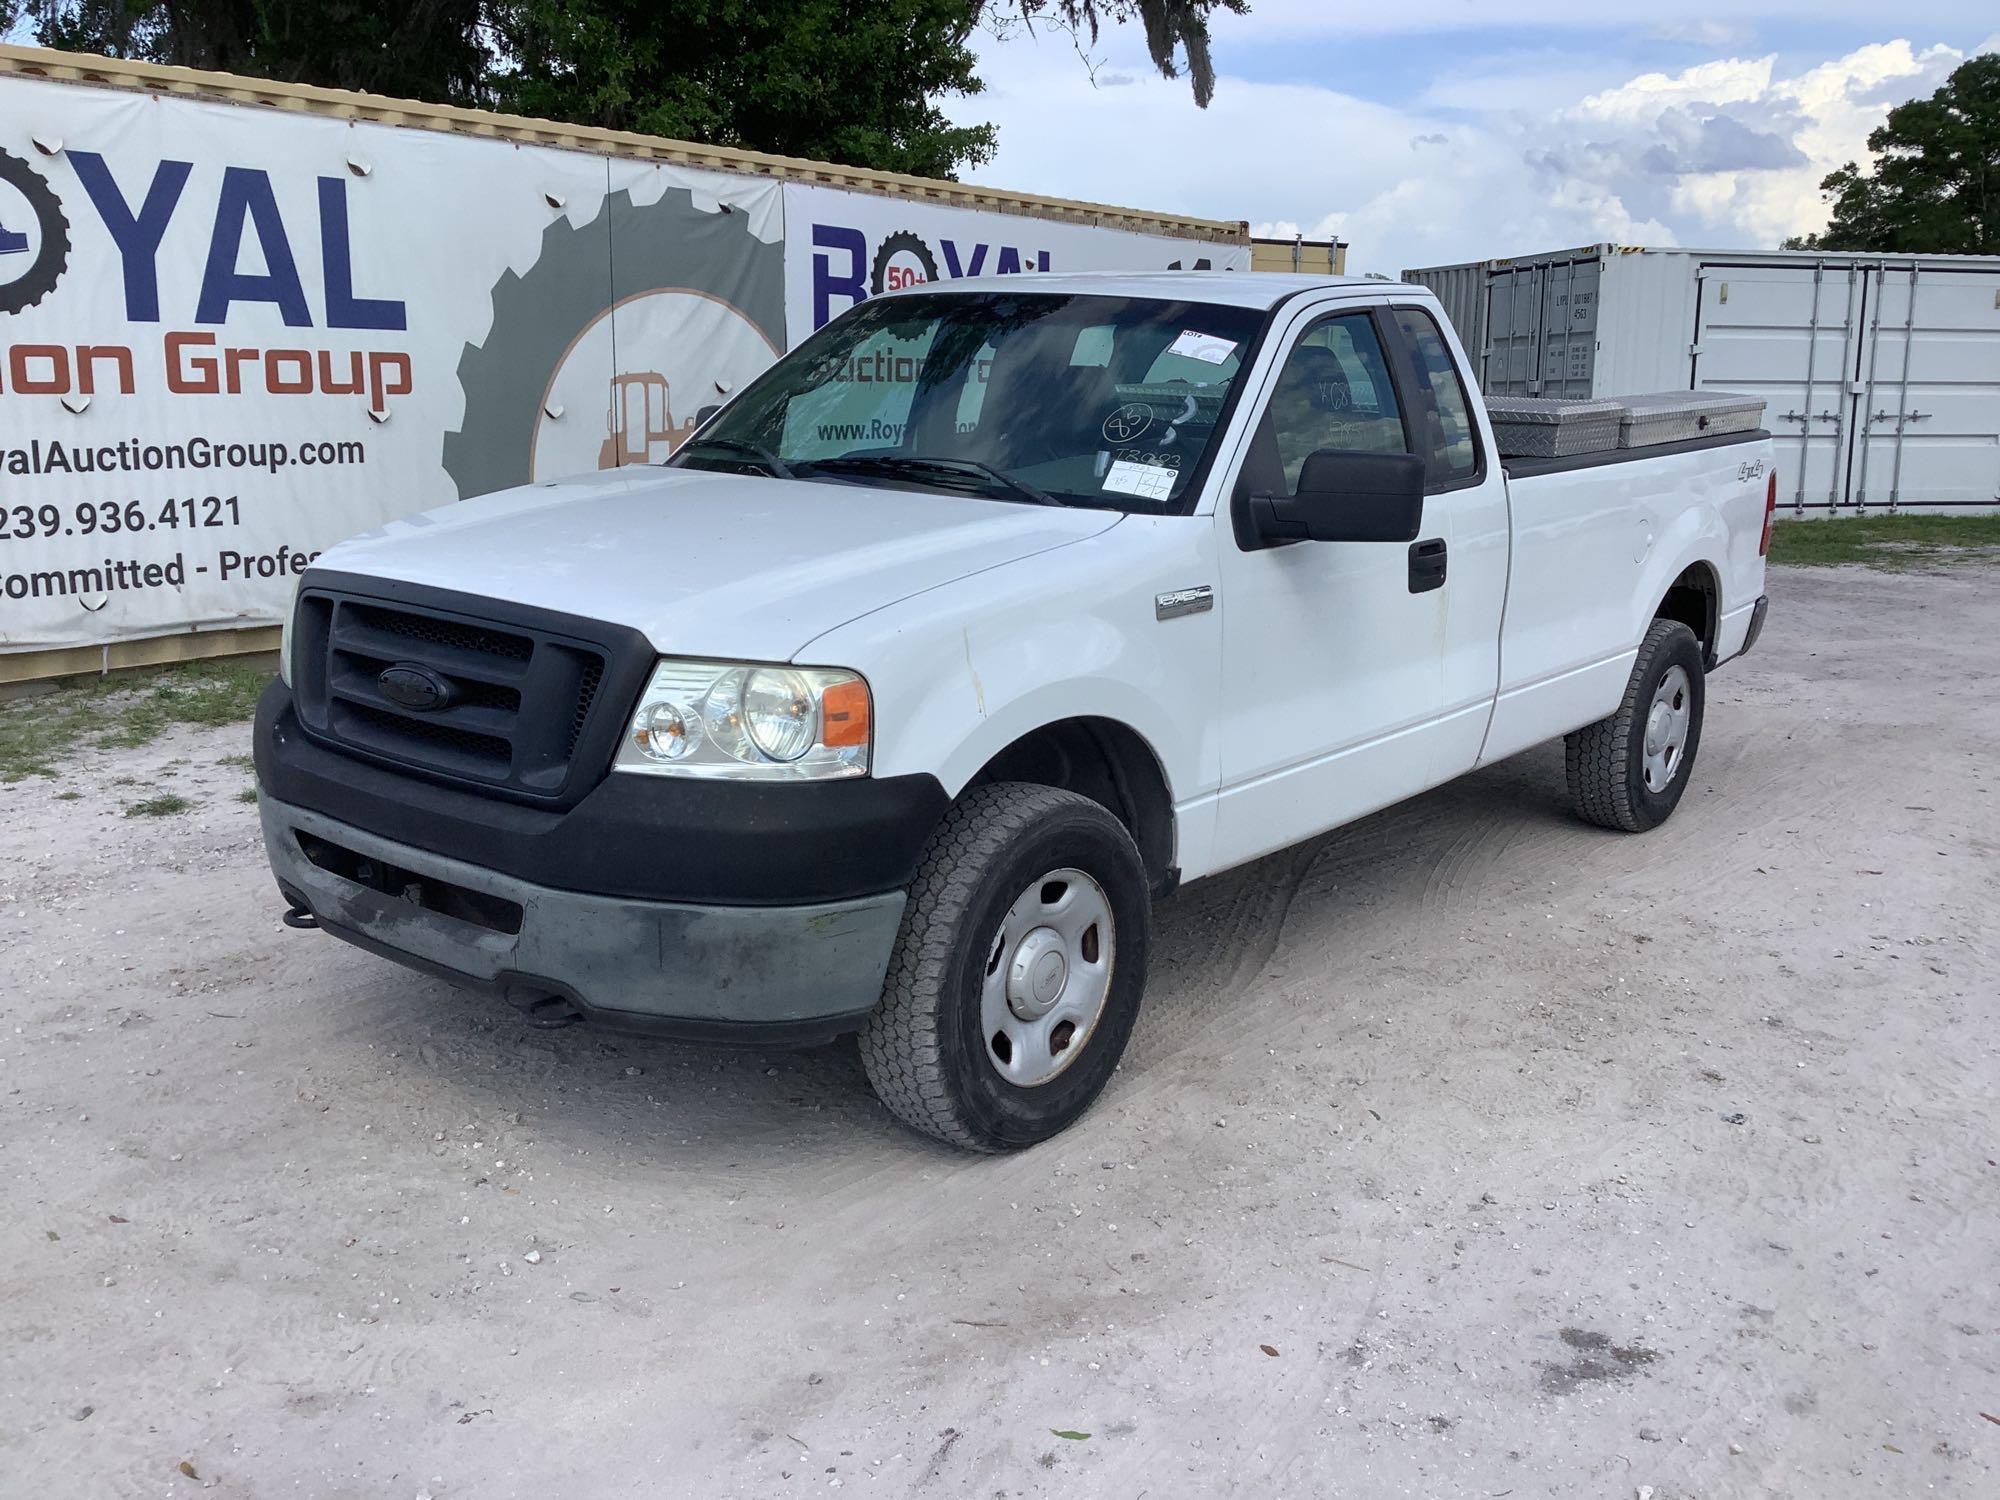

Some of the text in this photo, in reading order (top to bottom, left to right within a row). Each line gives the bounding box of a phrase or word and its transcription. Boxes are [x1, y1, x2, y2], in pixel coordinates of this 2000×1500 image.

[1183, 330, 1203, 339] LOT#
[0, 331, 413, 413] on Group
[0, 436, 365, 475] alAuctionGroup.com
[0, 553, 185, 600] ommitted
